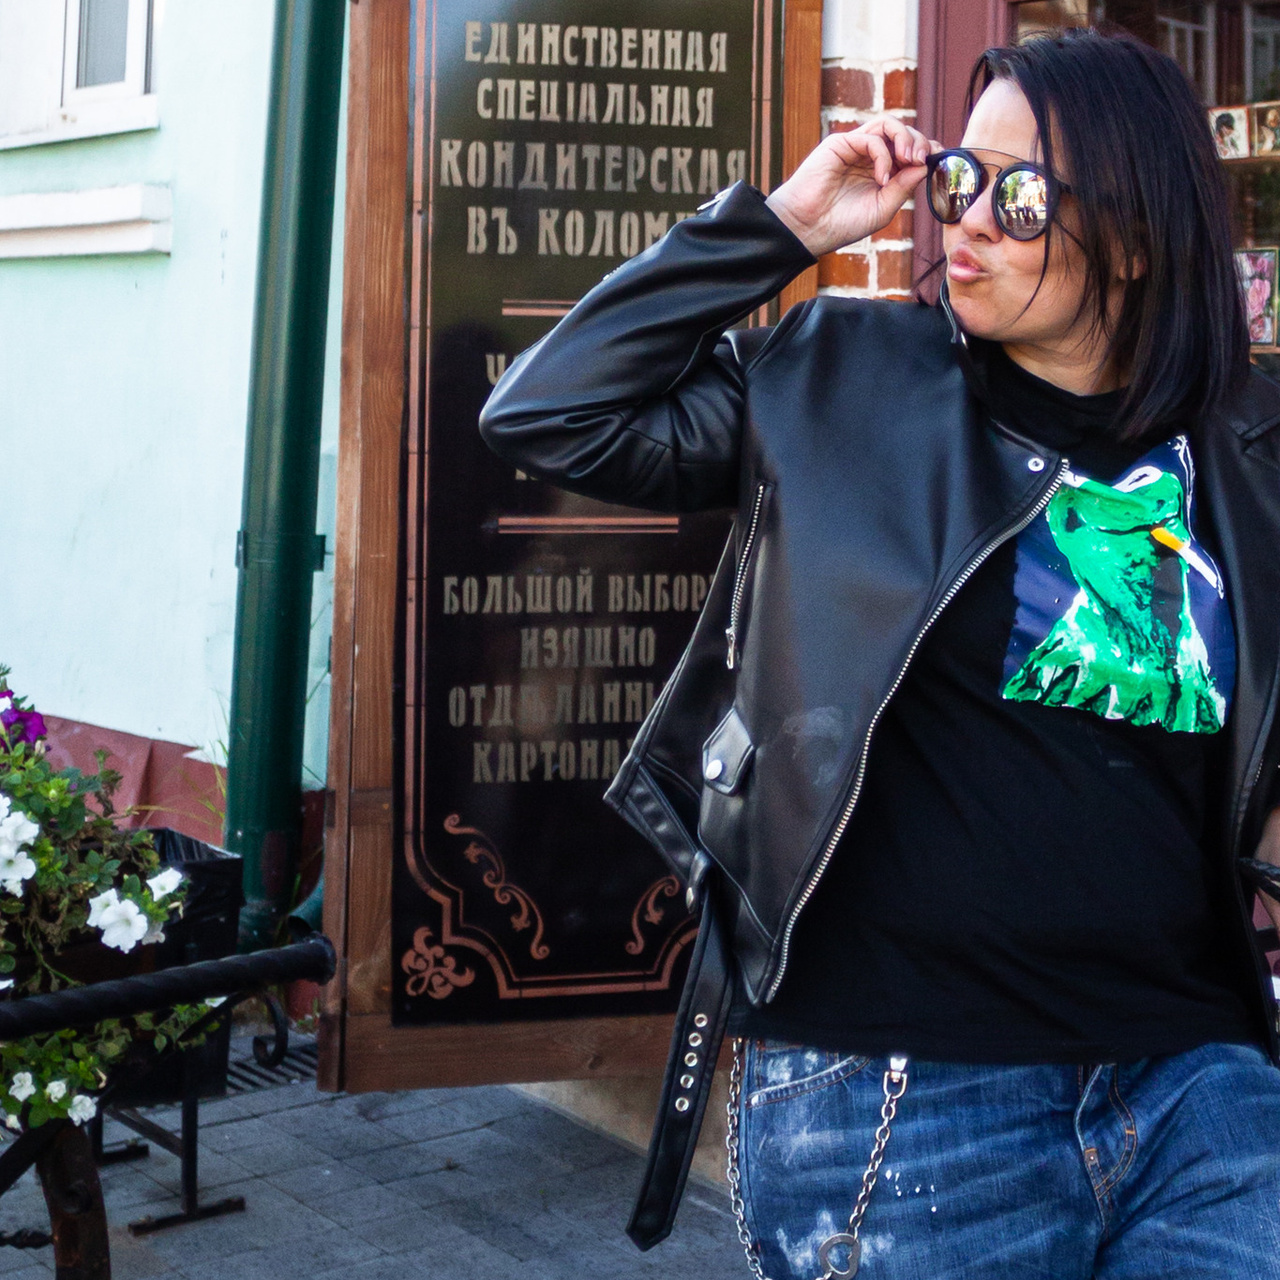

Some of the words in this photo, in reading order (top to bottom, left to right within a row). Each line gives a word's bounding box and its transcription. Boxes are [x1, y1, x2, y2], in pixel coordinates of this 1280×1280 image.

[464, 21, 728, 72] ЕДИНСТВЕННАЯ
[439, 138, 747, 195] КОНДИТЕРСКАЯ
[466, 206, 518, 255] ВЪ
[538, 207, 698, 257] КОЛОМ
[442, 566, 593, 615] БОЛЬШОЙ
[607, 573, 716, 614] ВЫБОР
[473, 738, 637, 784] КАРТОНА
